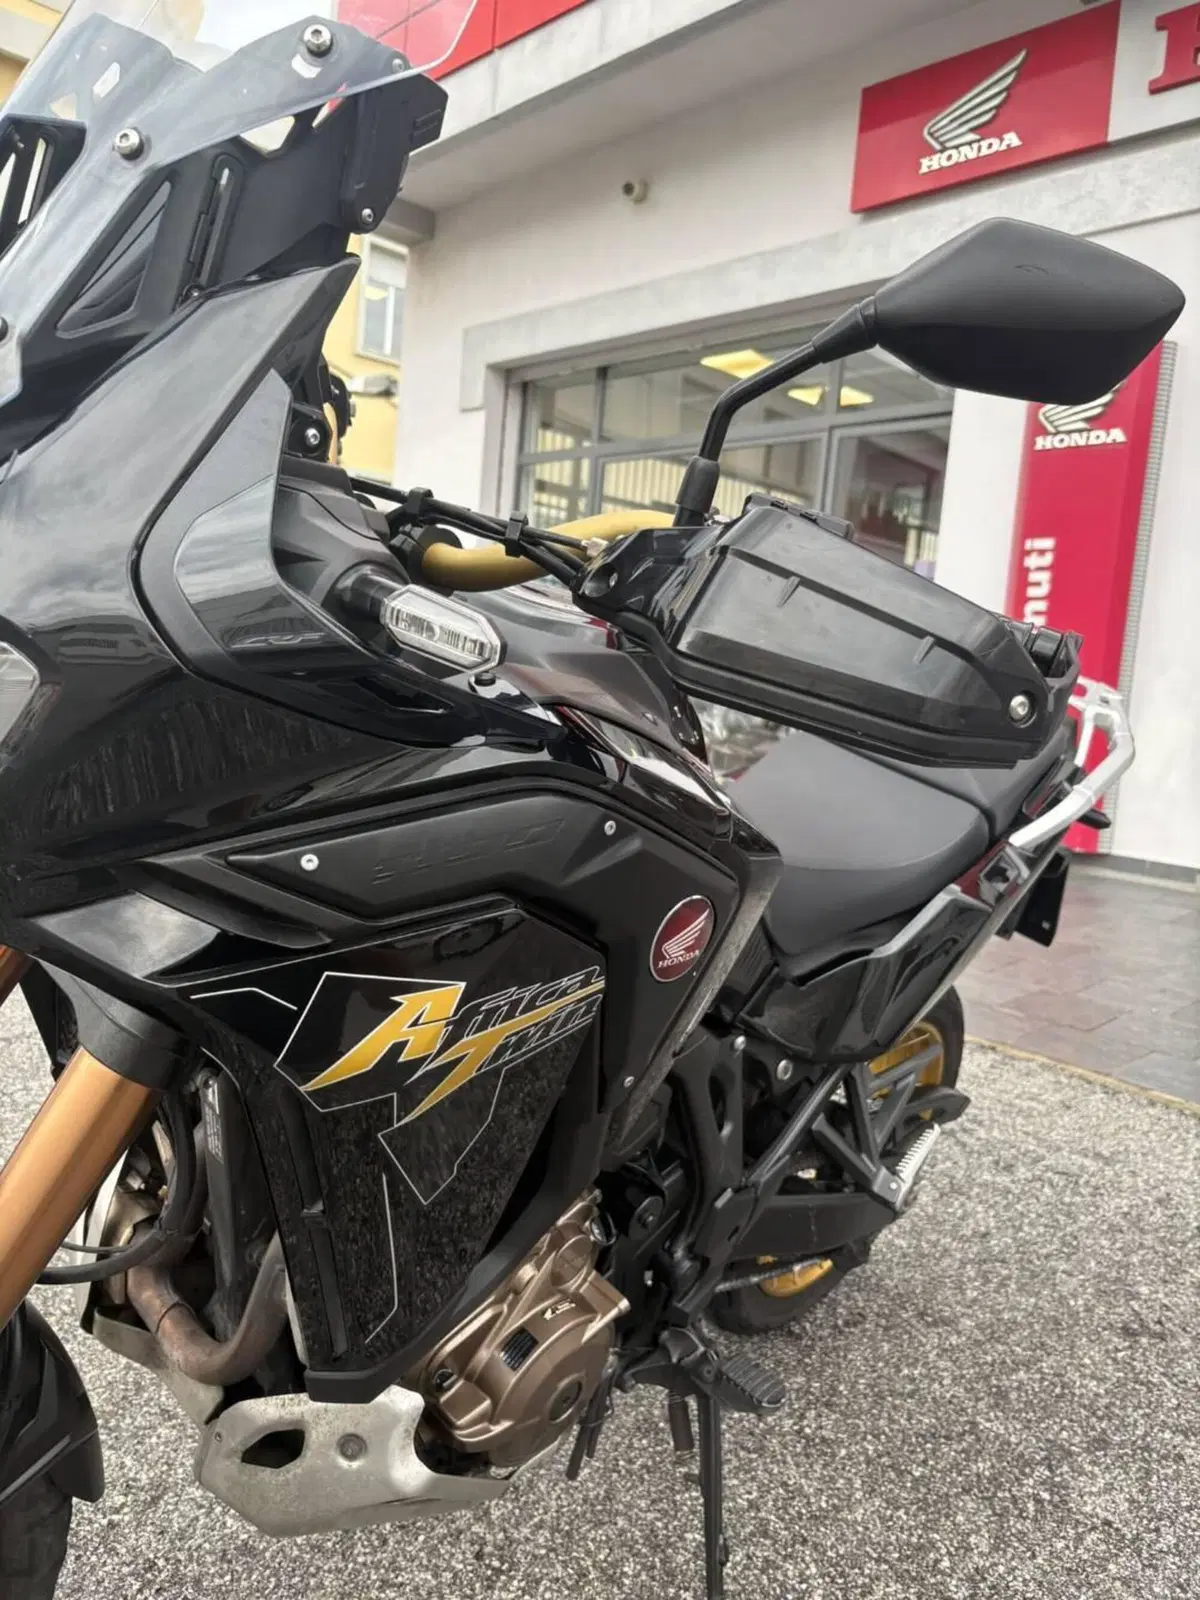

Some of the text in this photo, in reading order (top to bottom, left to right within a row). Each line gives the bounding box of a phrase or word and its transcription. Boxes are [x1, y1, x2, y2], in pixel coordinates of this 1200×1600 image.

[918, 131, 1023, 175] HONDA
[1033, 428, 1128, 451] HONDA
[1022, 537, 1056, 631] nuti
[657, 949, 701, 968] HONDA
